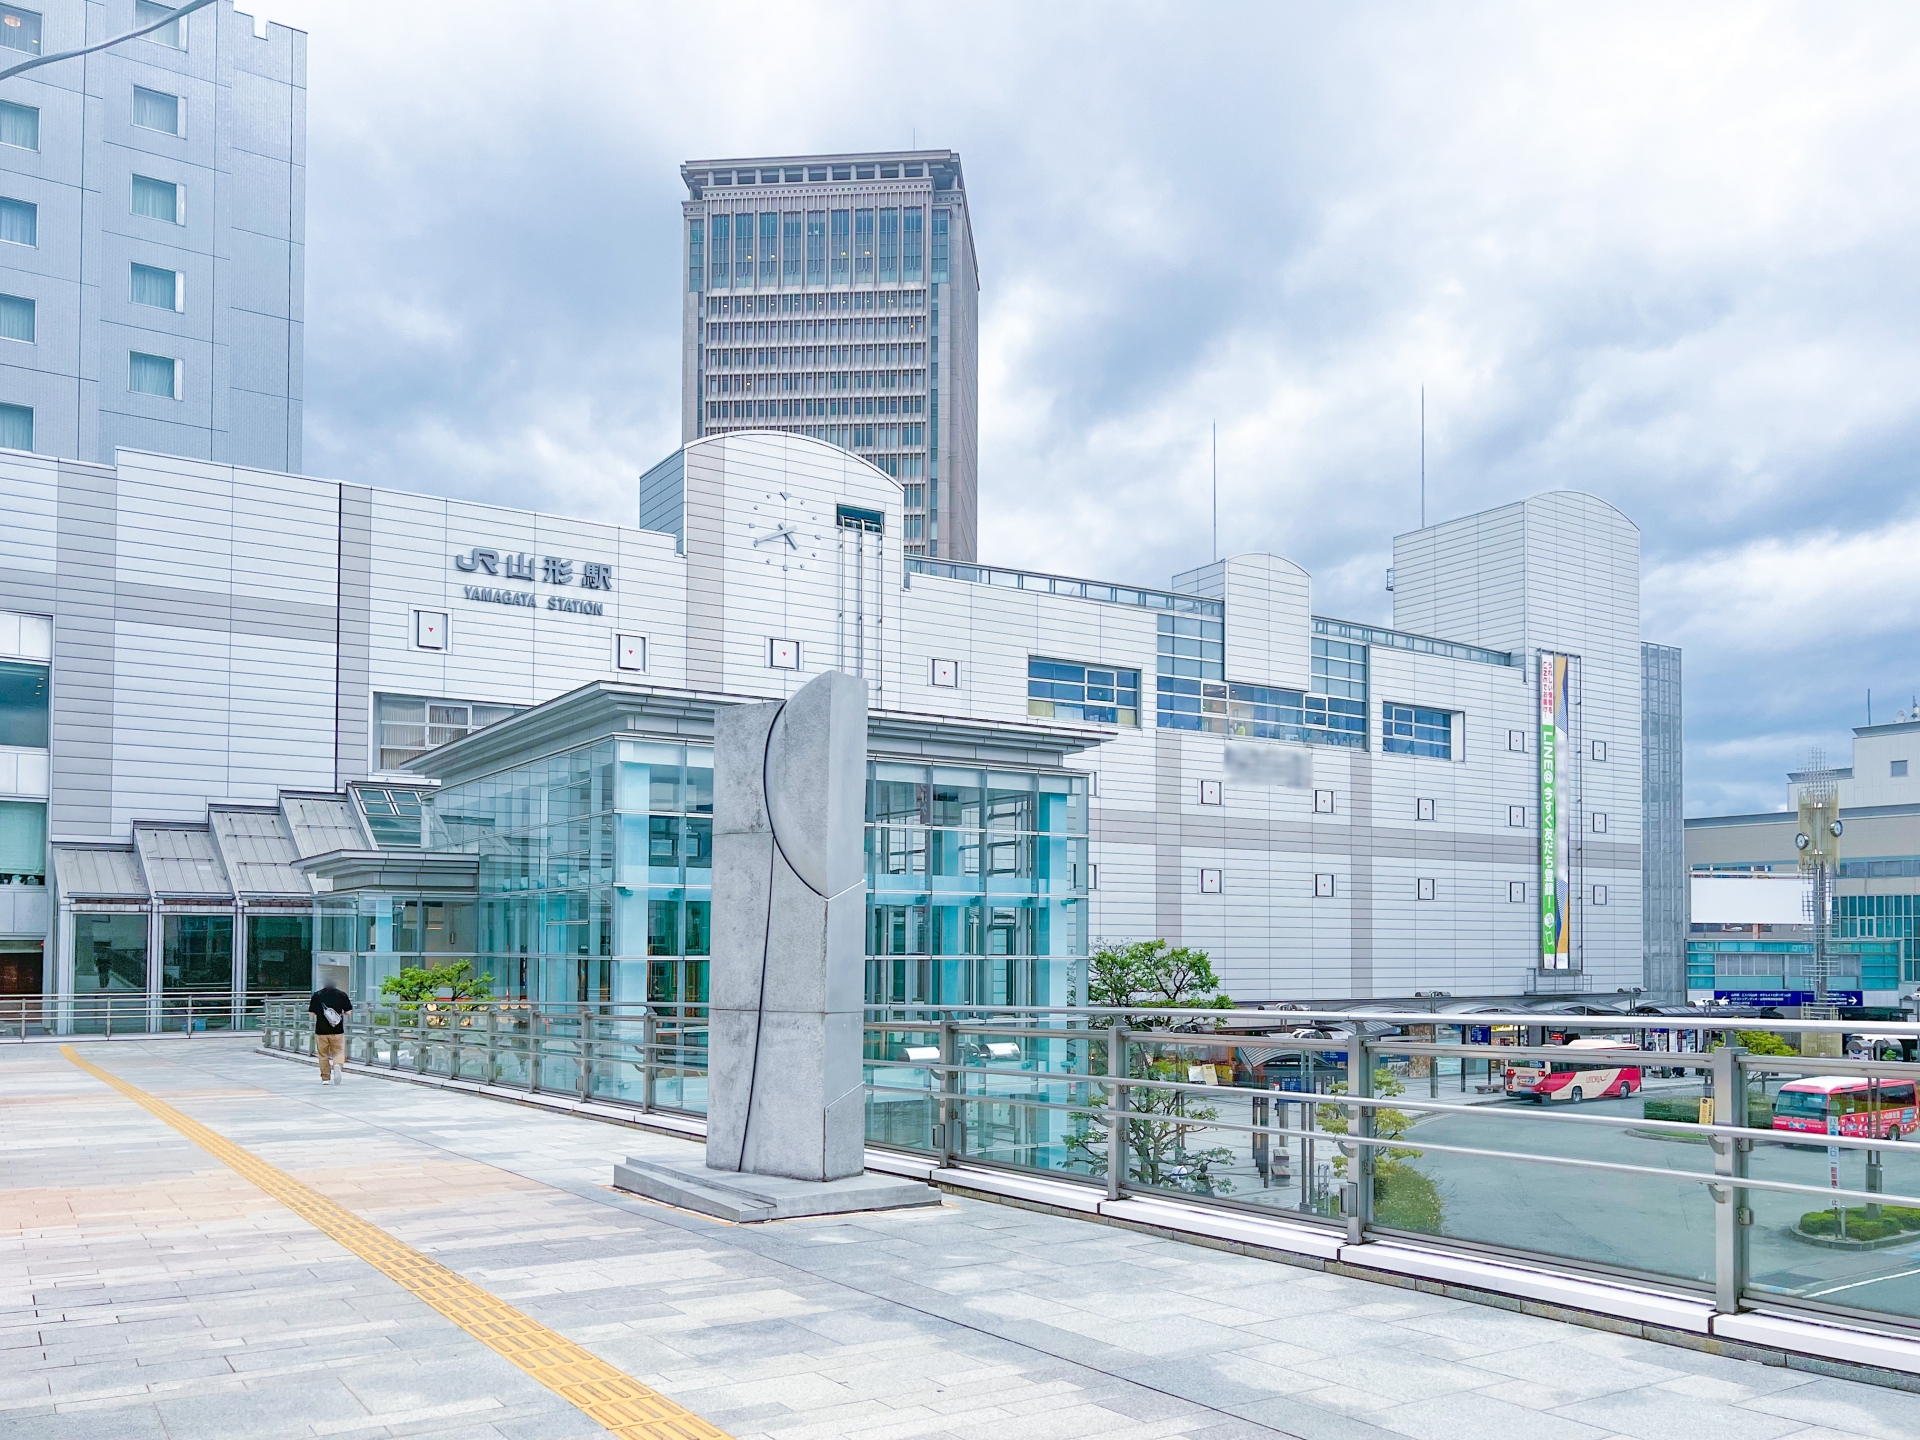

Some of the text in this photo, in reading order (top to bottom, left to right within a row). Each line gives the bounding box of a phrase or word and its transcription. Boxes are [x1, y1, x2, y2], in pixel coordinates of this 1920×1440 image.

[456, 548, 612, 590] JR山形駅
[464, 586, 603, 616] YAMAGATA STATION
[1543, 731, 1553, 784] LINE@
